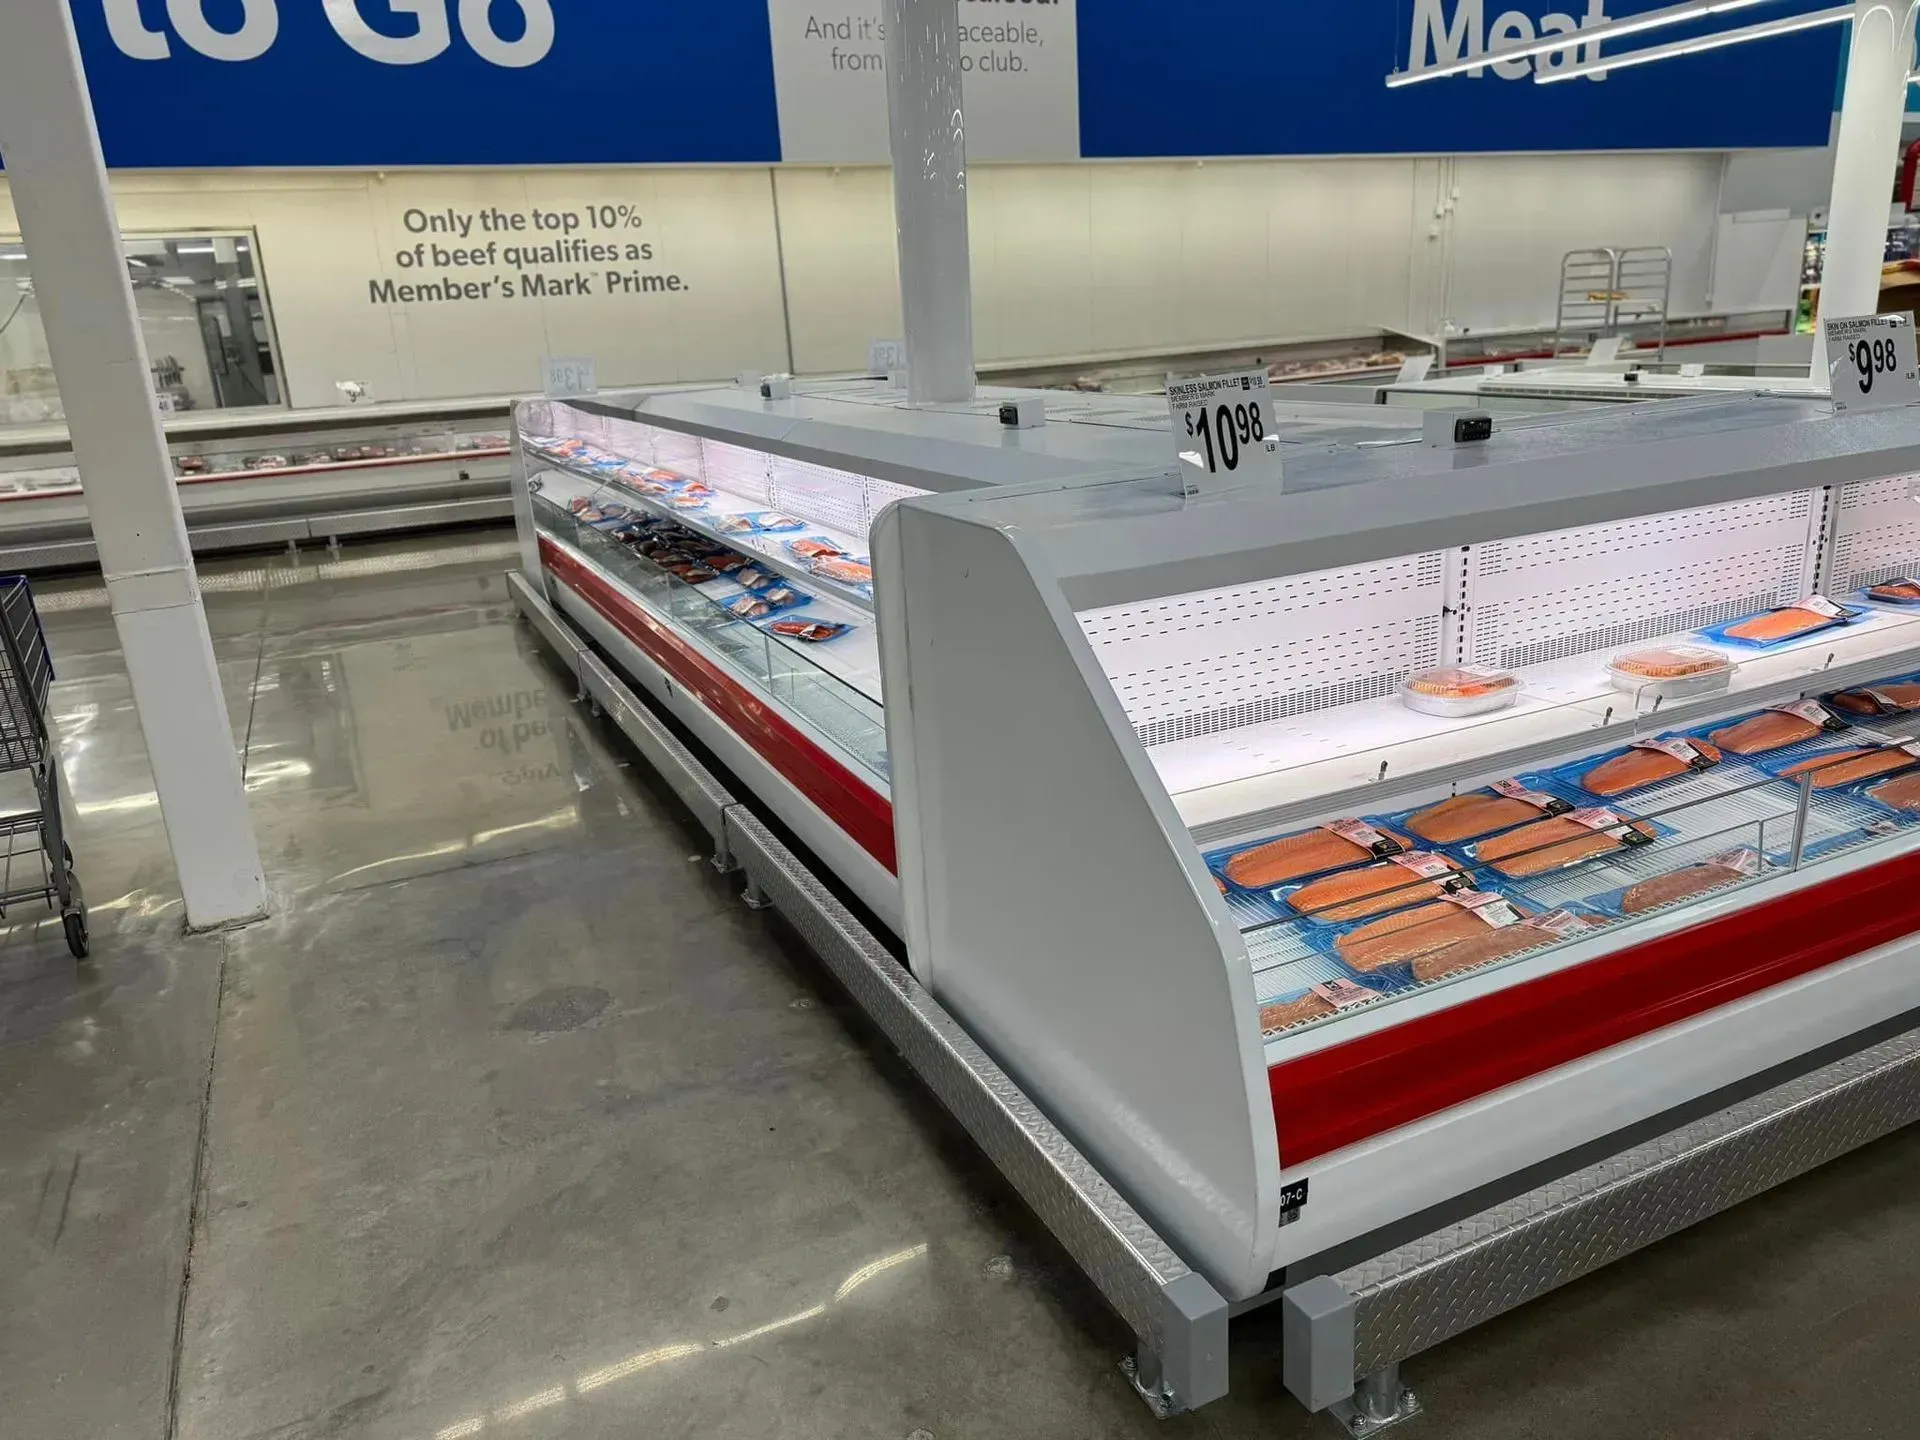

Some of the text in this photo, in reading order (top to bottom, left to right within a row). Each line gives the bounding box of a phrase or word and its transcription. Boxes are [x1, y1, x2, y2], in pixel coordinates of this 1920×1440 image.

[804, 15, 850, 41] And
[957, 20, 1044, 48] aceable,
[1406, 0, 1612, 81] Meat
[831, 47, 882, 71] from
[979, 50, 1028, 72] club.
[403, 204, 642, 238] Only the top 10%
[396, 239, 653, 270] of beef qualifies as
[369, 275, 515, 303] Member's
[605, 270, 689, 294] Prime.
[1169, 384, 1198, 396] SKINLESS
[1198, 380, 1221, 392] SALMON
[1222, 378, 1239, 388] FILLET
[1266, 443, 1276, 452] LB
